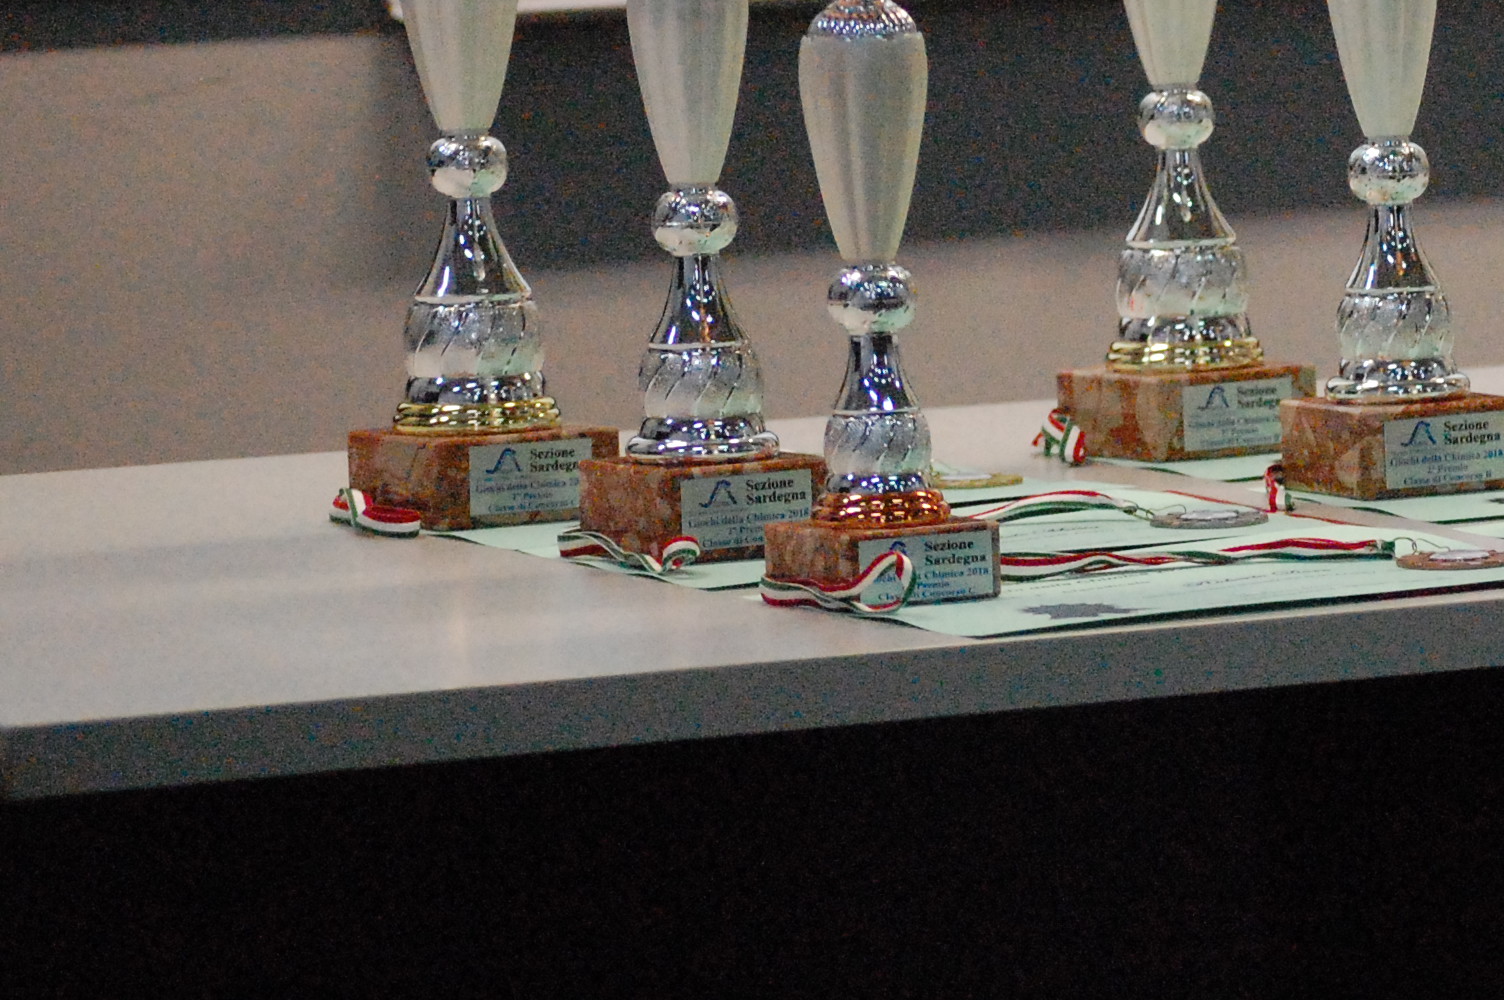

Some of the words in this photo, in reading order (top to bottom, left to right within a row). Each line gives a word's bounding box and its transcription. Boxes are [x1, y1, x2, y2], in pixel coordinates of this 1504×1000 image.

[1444, 419, 1489, 432] Sezione
[1443, 431, 1500, 445] Sardegna
[530, 447, 575, 460] Sezione
[530, 460, 579, 473] Sardegn
[746, 478, 794, 491] Sezione
[746, 490, 806, 505] Sardegna
[924, 540, 974, 552] Sezione
[924, 553, 986, 566] Sardegna
